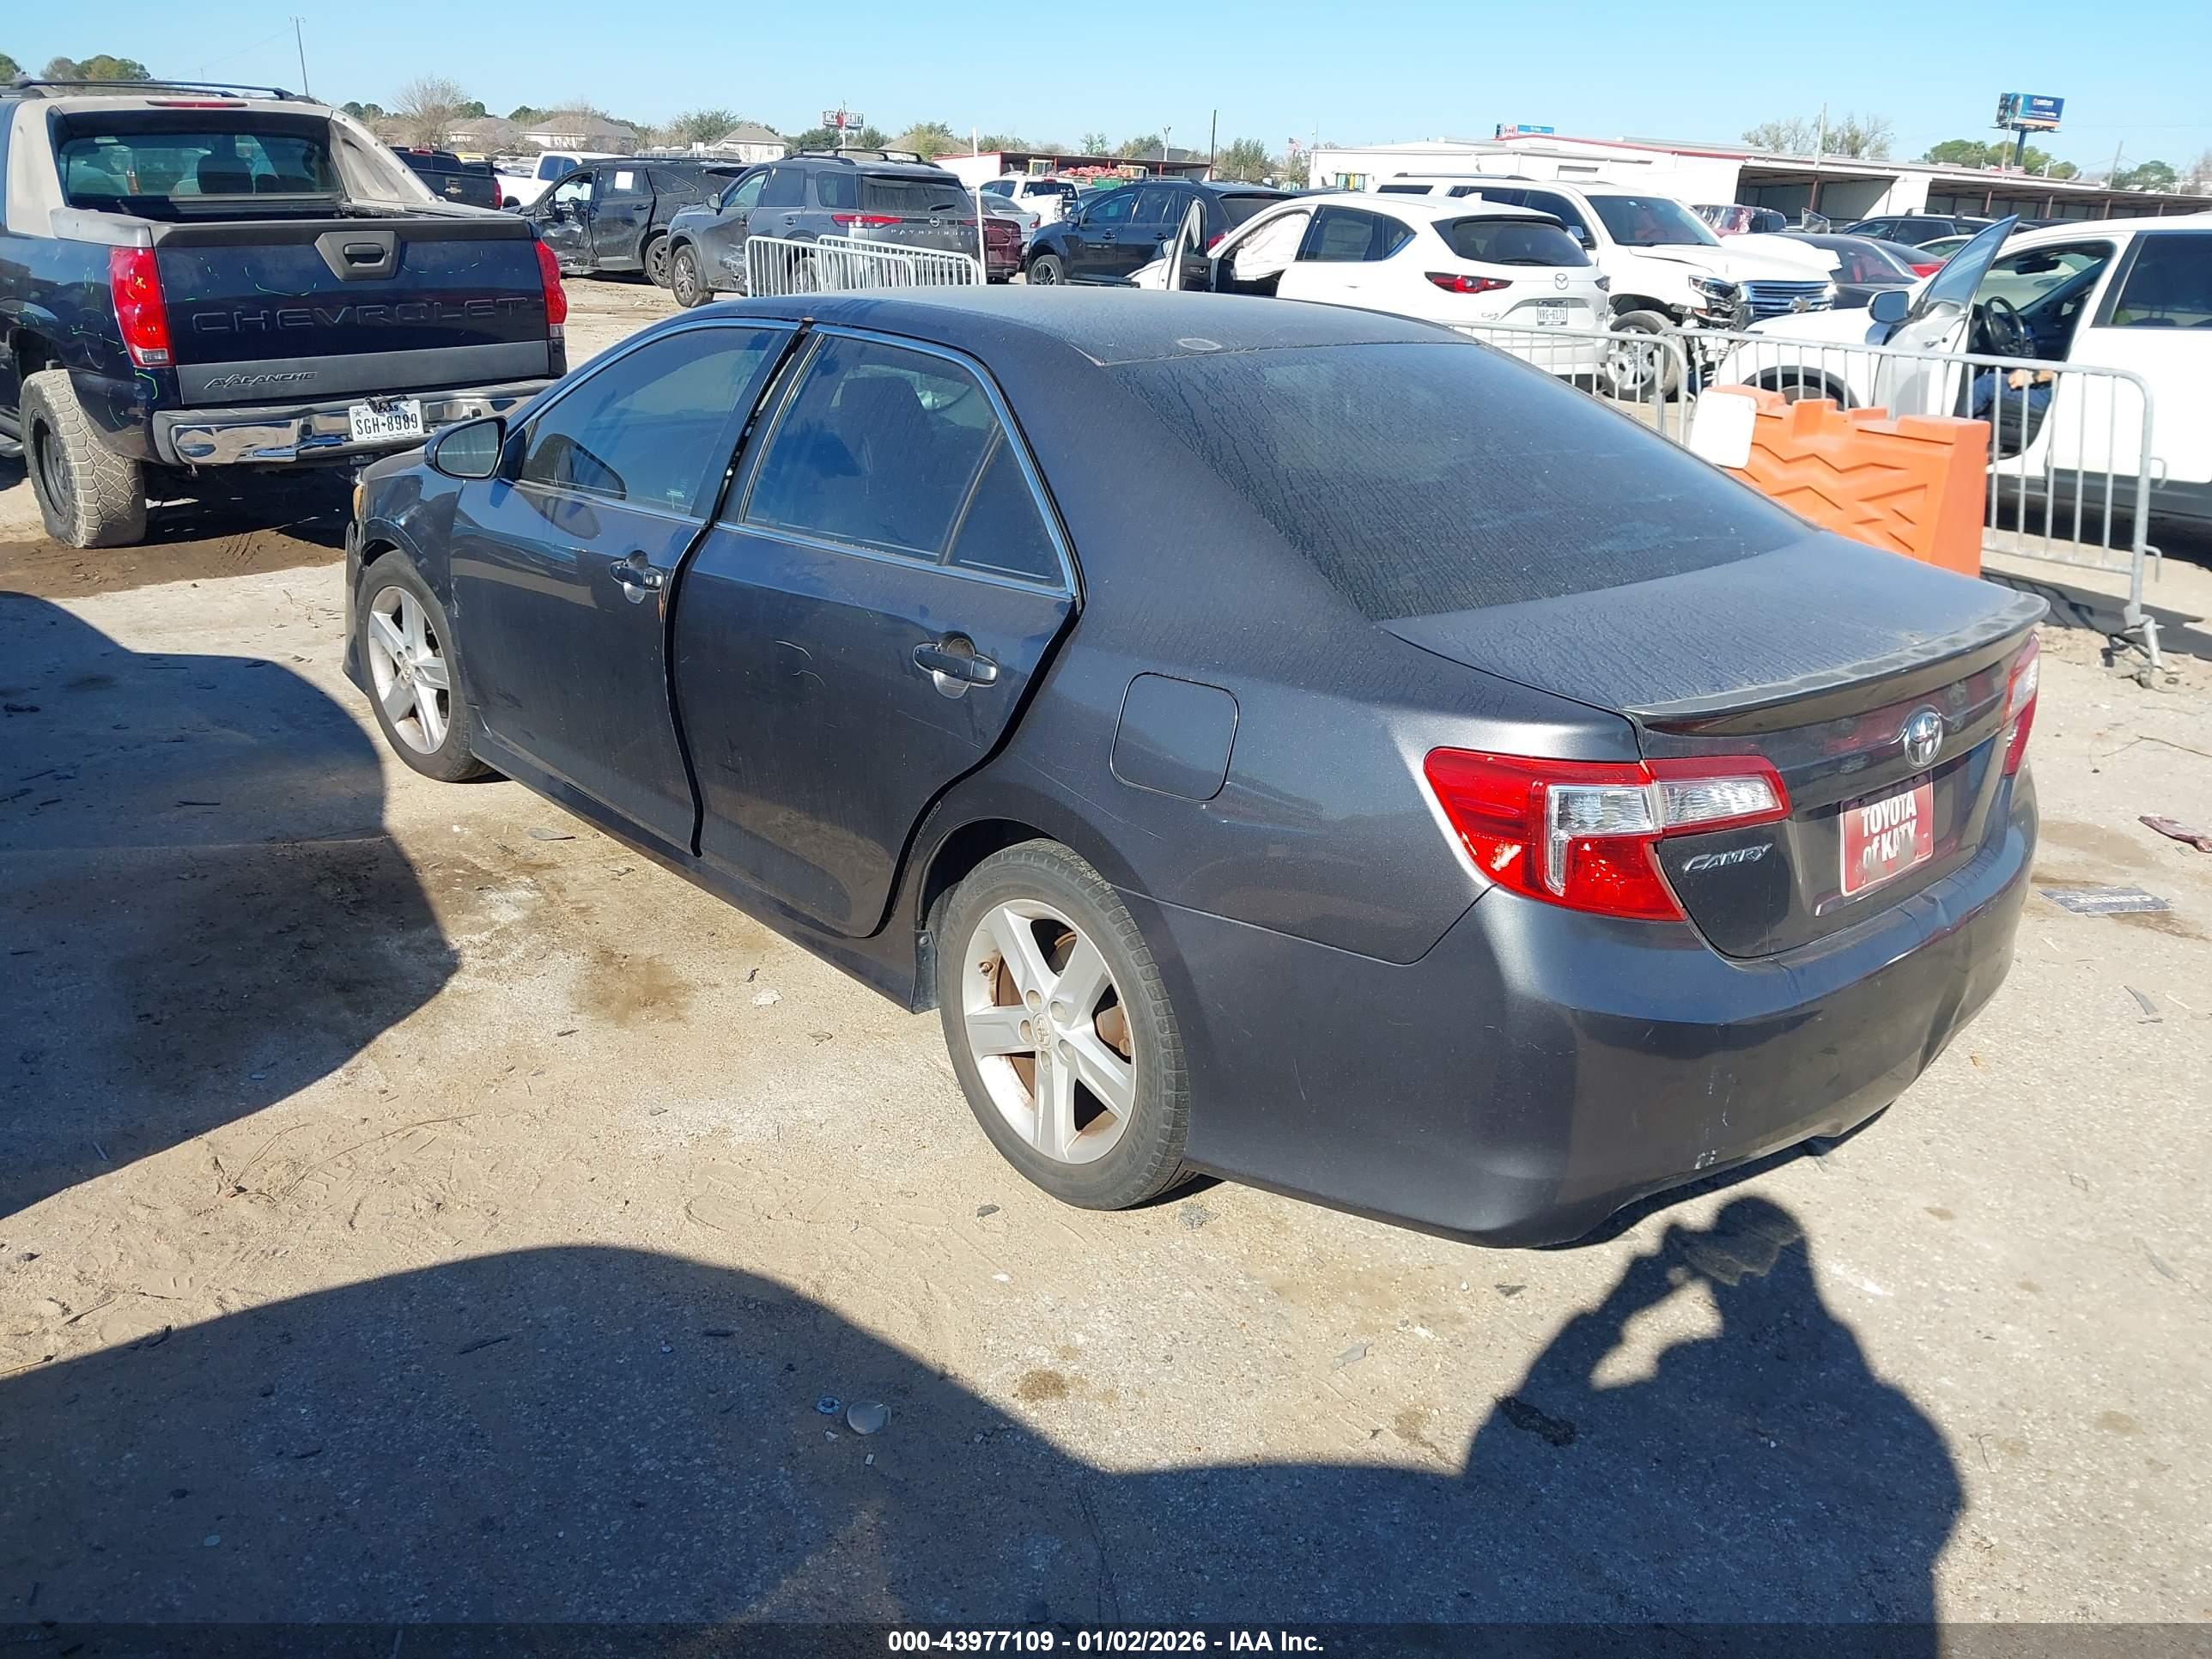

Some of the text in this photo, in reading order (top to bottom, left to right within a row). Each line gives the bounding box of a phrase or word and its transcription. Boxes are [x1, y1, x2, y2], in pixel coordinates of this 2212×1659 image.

[191, 296, 528, 333] CHEVROLET
[204, 371, 318, 390] AVALANCHE
[1862, 790, 1917, 838] TOYOTA
[1683, 842, 1773, 872] CAMRY
[1881, 819, 1917, 862] KATY
